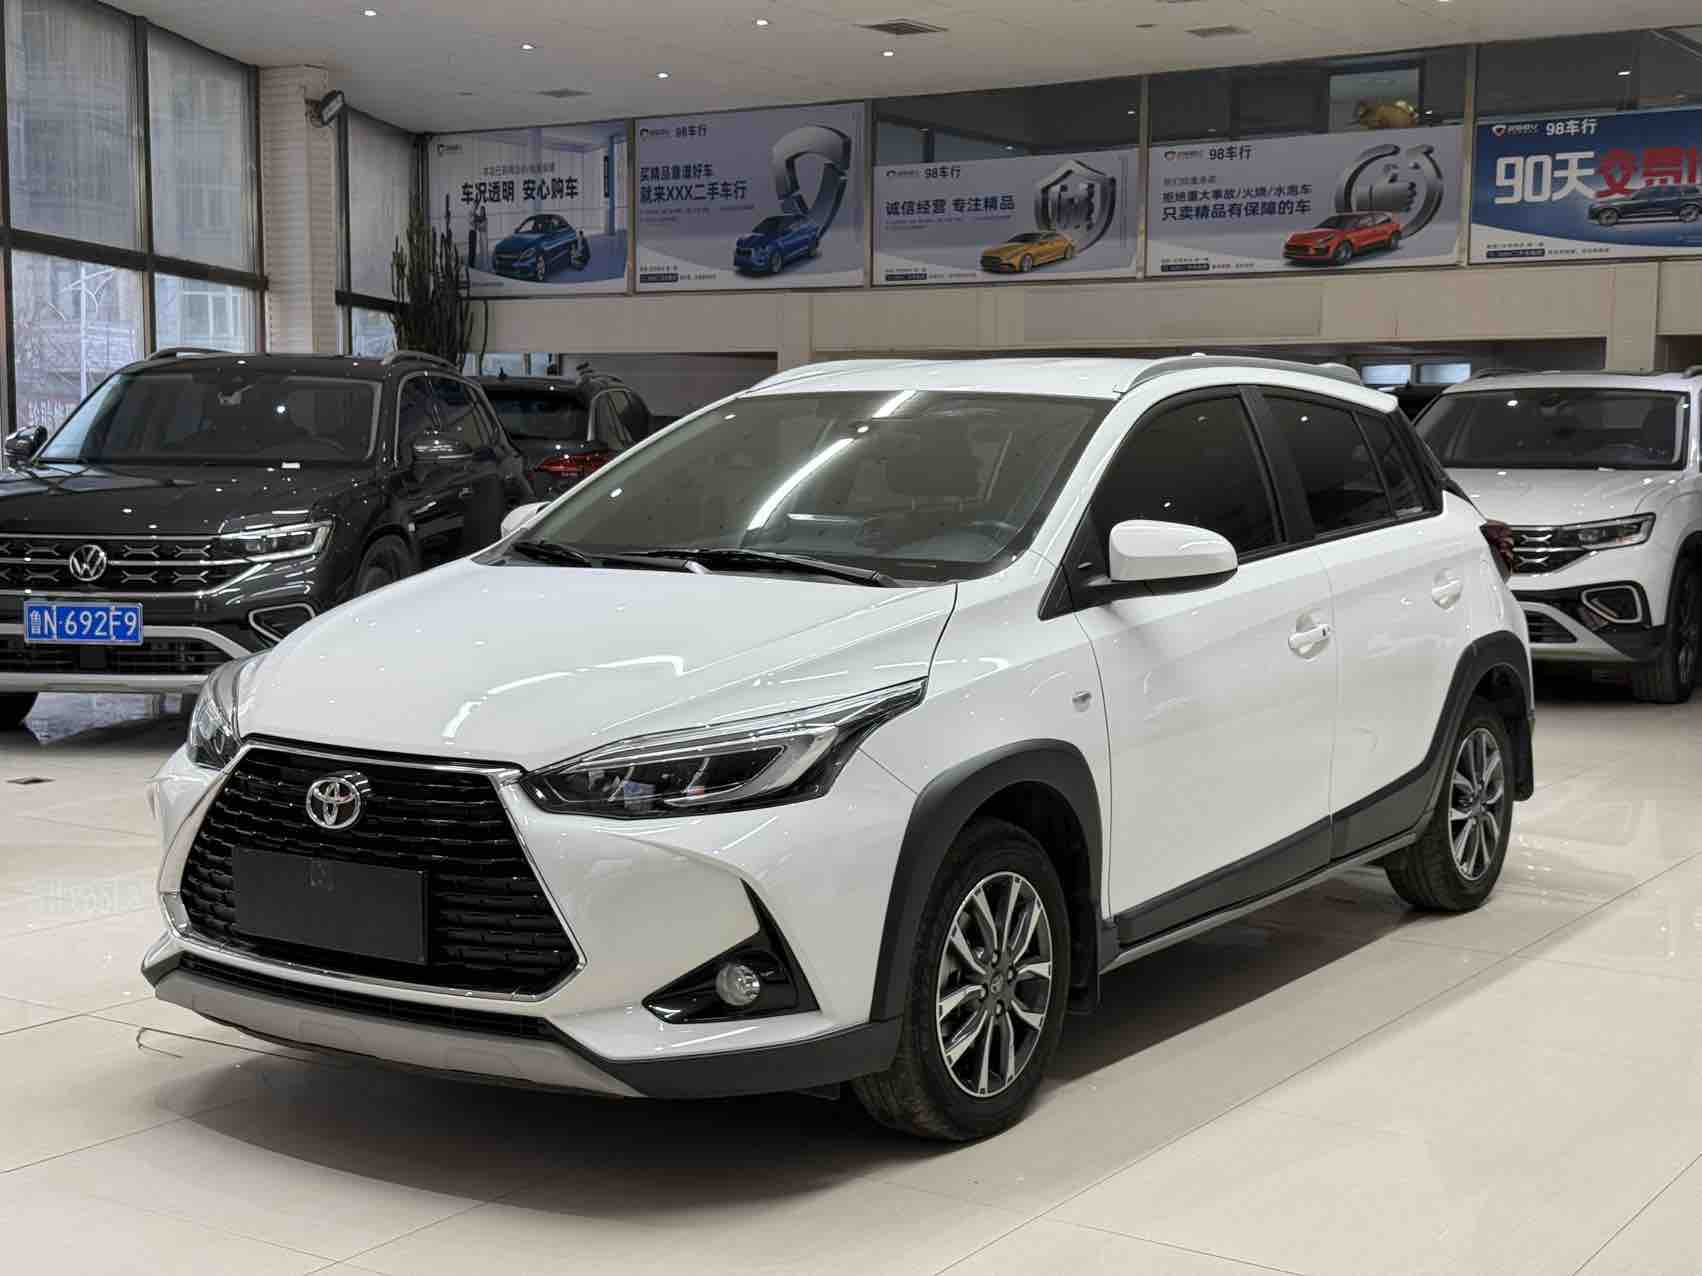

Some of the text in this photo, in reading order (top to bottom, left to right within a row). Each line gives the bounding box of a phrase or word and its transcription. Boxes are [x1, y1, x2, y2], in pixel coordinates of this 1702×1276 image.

[1545, 118, 1598, 136] 98车行
[1209, 145, 1252, 161] 98车行
[925, 165, 961, 179] 98车行
[461, 177, 579, 204] 车况透明 安心购车
[640, 180, 748, 203] 就来XXX二手车行
[886, 195, 1015, 216] 诚信经营 专注精品
[1161, 200, 1312, 221] 只卖精品有保障的车
